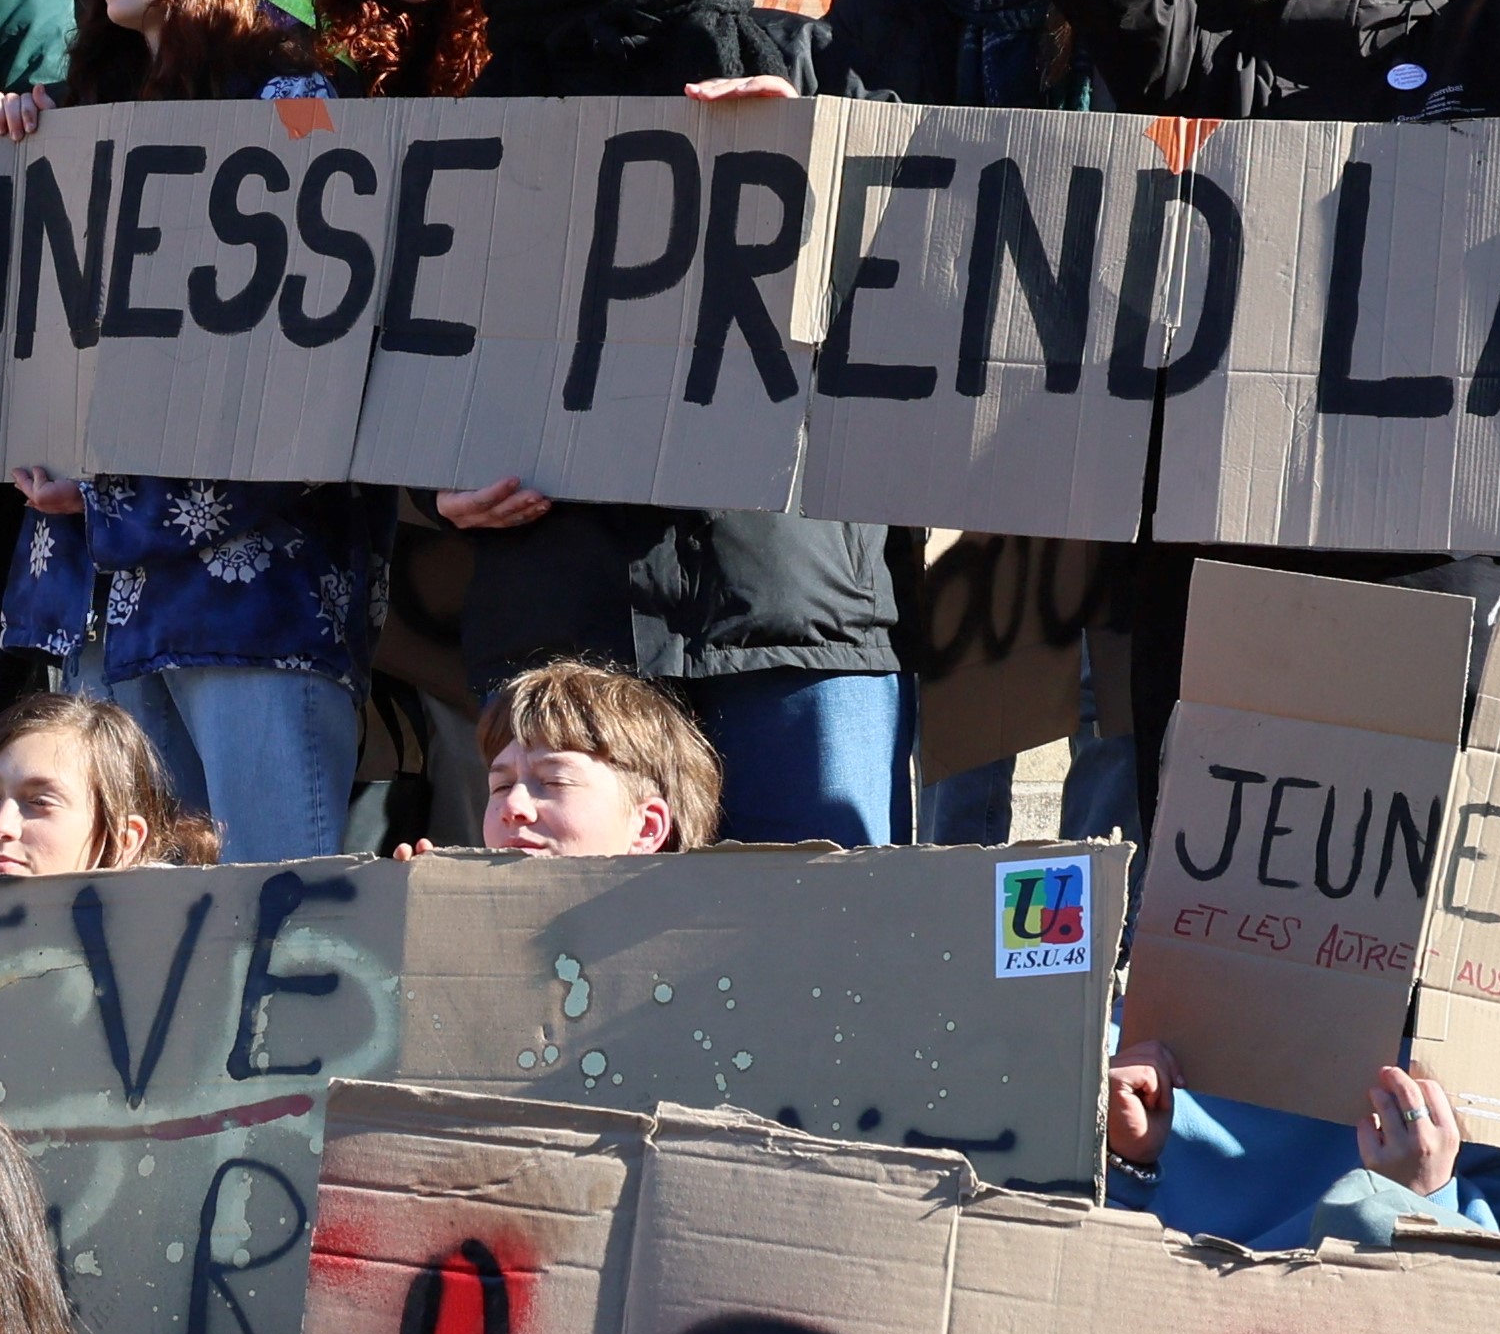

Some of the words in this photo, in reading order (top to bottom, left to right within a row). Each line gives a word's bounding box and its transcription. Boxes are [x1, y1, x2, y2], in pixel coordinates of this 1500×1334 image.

[561, 127, 1247, 414] PREND
[1004, 948, 1062, 973] F.S.U.
[1062, 946, 1087, 966] 48
[1174, 904, 1230, 939] ET
[1236, 913, 1303, 952] LES
[1315, 920, 1440, 979] AUTRES
